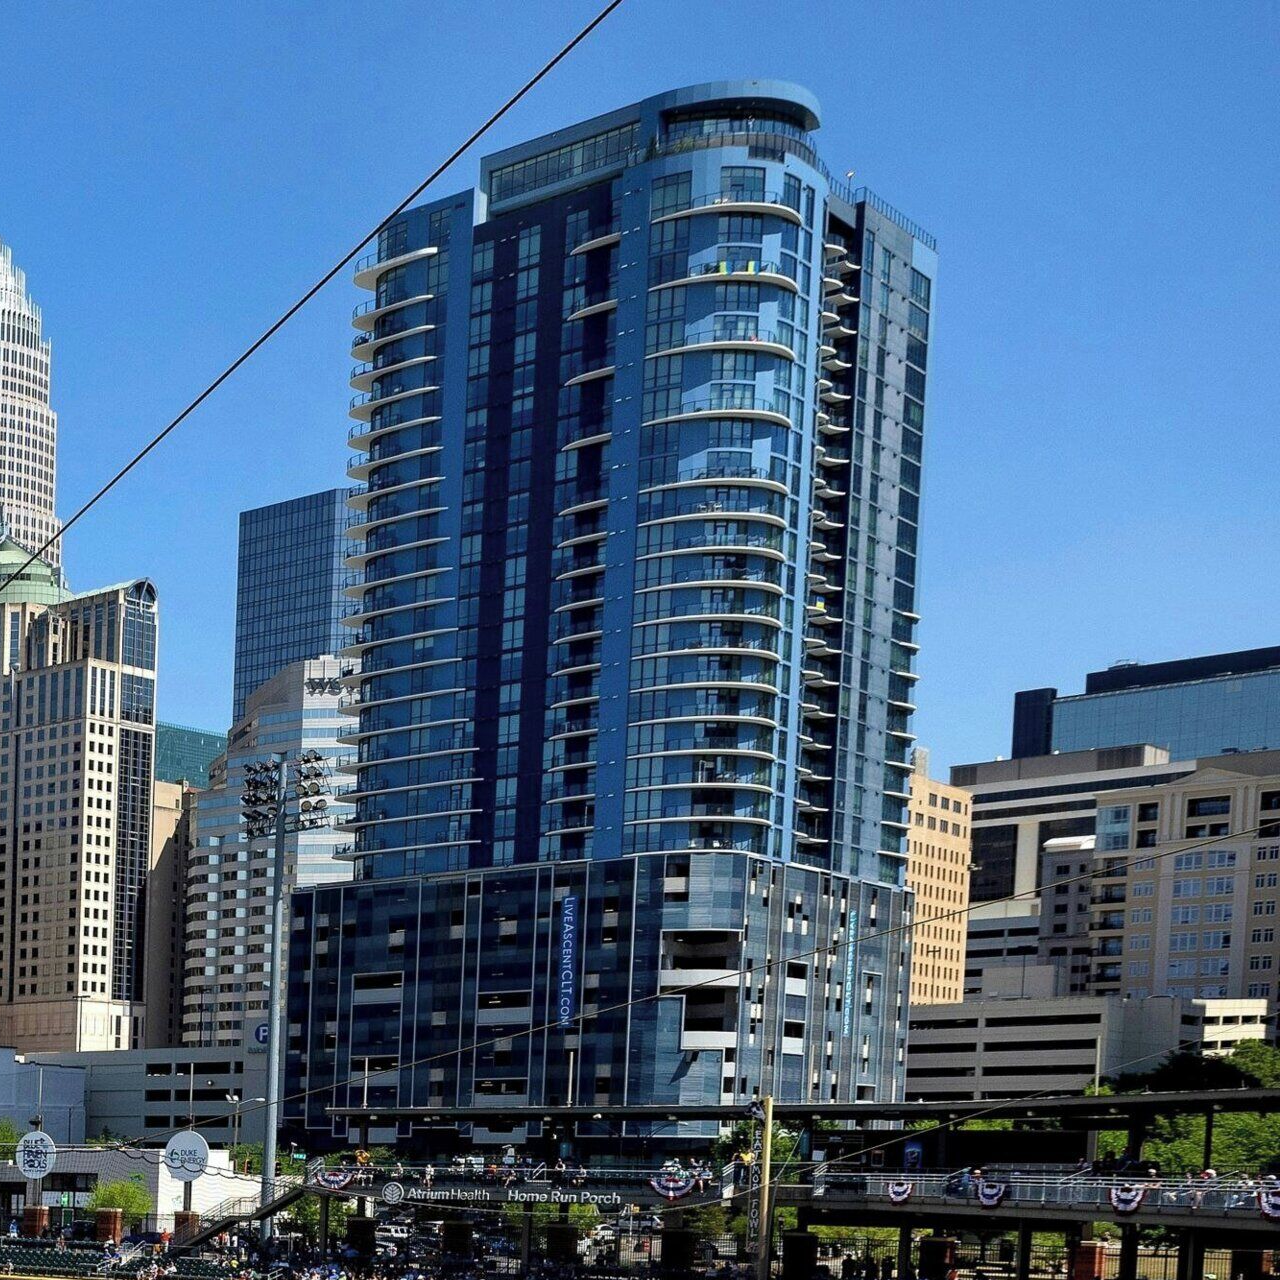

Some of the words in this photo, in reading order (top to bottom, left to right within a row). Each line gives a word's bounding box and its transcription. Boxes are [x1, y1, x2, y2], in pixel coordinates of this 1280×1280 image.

[753, 1130, 763, 1160] EAT
[508, 1189, 548, 1202] Home
[551, 1190, 577, 1203] Run
[581, 1191, 621, 1204] Porch
[749, 1199, 760, 1237] FOWL
